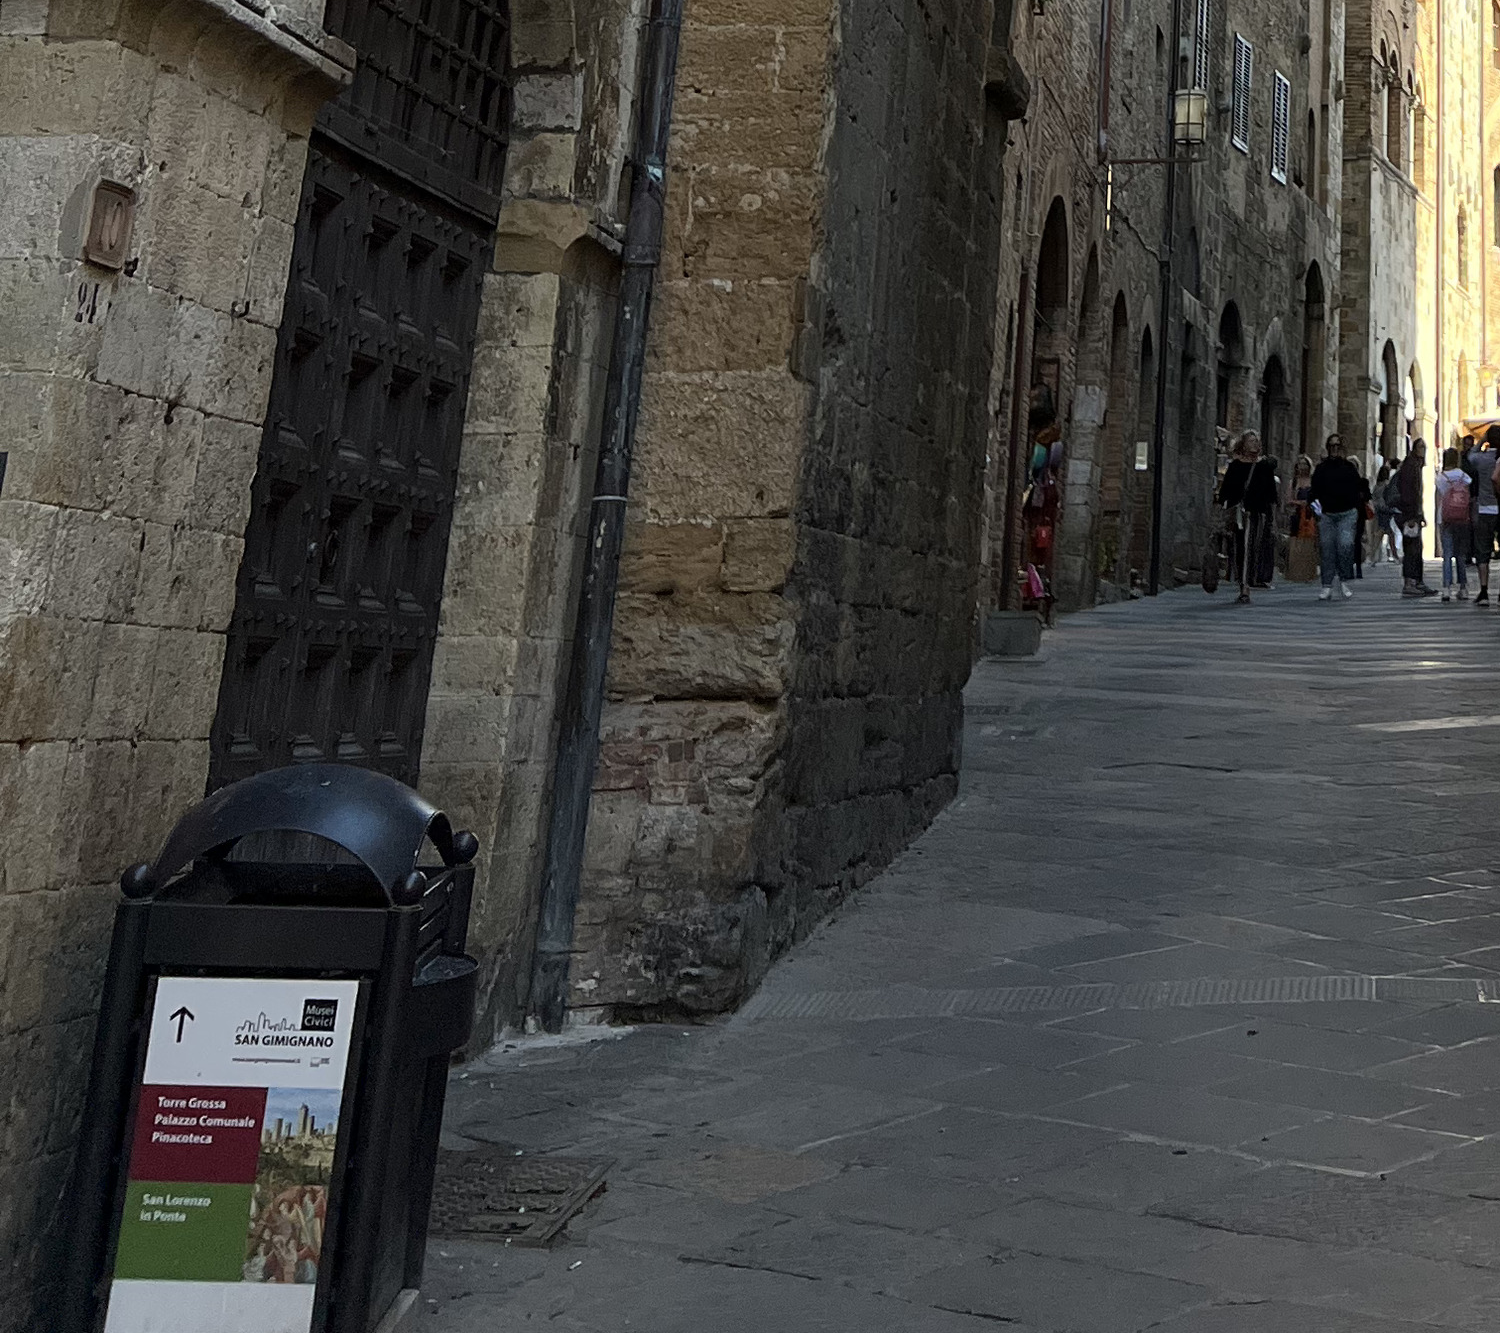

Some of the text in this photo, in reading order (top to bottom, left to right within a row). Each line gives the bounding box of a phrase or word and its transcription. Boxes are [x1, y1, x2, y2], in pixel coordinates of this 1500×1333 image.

[305, 1004, 335, 1016] Musei
[304, 1016, 333, 1027] Civici
[234, 1034, 334, 1048] SAN GIMIGNANO
[158, 1096, 227, 1109] Torre Grossa
[154, 1113, 256, 1128] Palazzo Comunale
[151, 1131, 213, 1144] Pinacoteca
[142, 1193, 212, 1207] San Lorenzo
[139, 1209, 187, 1222] in Ponte
